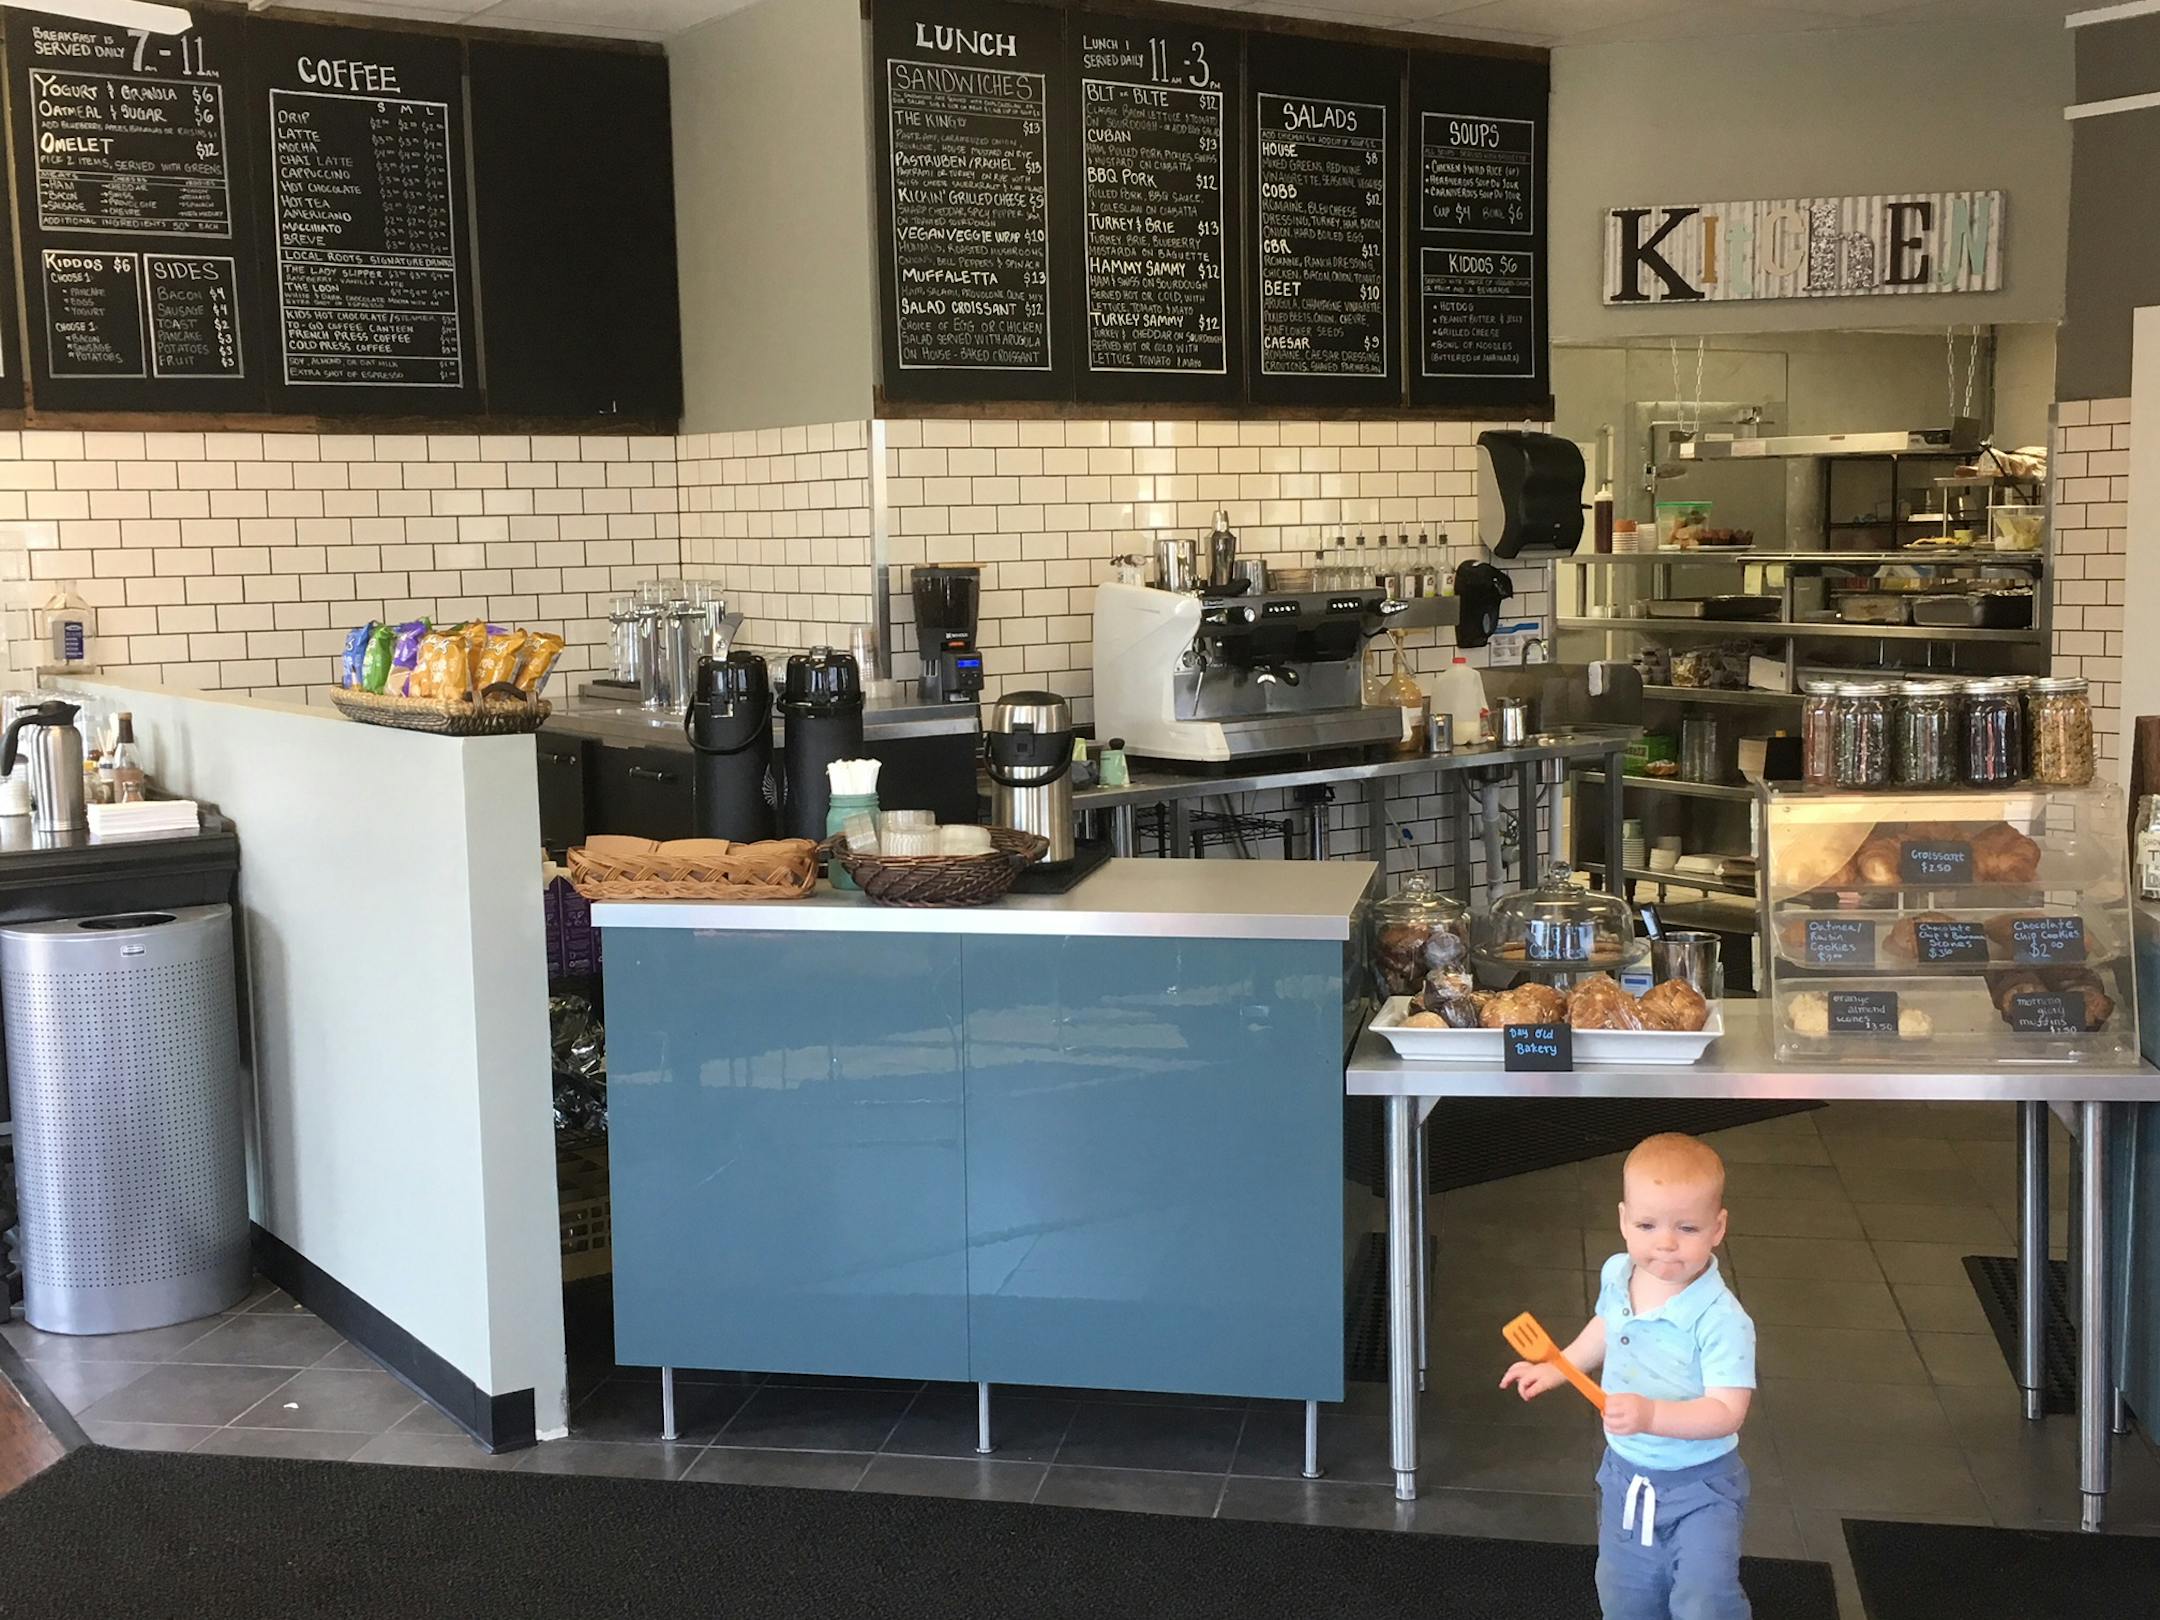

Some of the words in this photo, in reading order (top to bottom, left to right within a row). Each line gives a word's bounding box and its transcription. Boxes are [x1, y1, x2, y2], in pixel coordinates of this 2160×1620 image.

[32, 26, 97, 45] BREAKFAST
[104, 35, 114, 45] IS
[915, 21, 1017, 57] LUNCH
[1083, 35, 1118, 50] LUNCH
[34, 40, 90, 57] SERVED
[95, 45, 126, 58] DAILY
[1083, 54, 1119, 69] SERVED
[1120, 54, 1143, 68] DAILY
[297, 56, 401, 93] COFFEE
[34, 74, 99, 100] YOGURT
[121, 86, 177, 101] GRANOLA
[192, 86, 214, 105] $6
[895, 64, 1033, 101] SANDWICHES
[1087, 83, 1115, 102] BLT
[1133, 87, 1169, 107] BLTE
[1200, 94, 1218, 110] $12
[39, 100, 102, 119] OATMEAL
[121, 104, 167, 123] SUGAR
[194, 105, 214, 127] $6
[278, 110, 311, 125] DRIP
[1283, 102, 1358, 132] SALADS
[894, 110, 921, 126] THE
[1022, 120, 1041, 136] $13
[278, 128, 321, 143] LATTE
[1088, 129, 1132, 143] CUBAN
[1199, 137, 1217, 151] $13
[1450, 121, 1500, 148] SOUPS
[40, 132, 114, 154] OMELET
[195, 141, 219, 160] $12
[278, 142, 318, 154] MOCHA
[1262, 142, 1298, 158] HOUSE
[1365, 152, 1378, 165] $8
[40, 156, 63, 165] PICK
[67, 156, 74, 165] 2
[115, 159, 156, 172] SERVED
[161, 162, 181, 173] WITH
[184, 164, 222, 175] GREENS
[280, 154, 312, 166] CHAI
[317, 156, 354, 167] LATTE
[280, 167, 351, 180] CAPPUCCINO
[1025, 161, 1042, 176] $13
[1087, 167, 1118, 183] BBQ
[1122, 168, 1157, 188] PORK
[1196, 174, 1218, 190] $12
[280, 181, 304, 193] HOT
[308, 182, 363, 195] CHOCOLATE
[1262, 183, 1298, 199] COBB
[1365, 193, 1382, 206] $12
[307, 197, 331, 209] TEA
[949, 191, 992, 206] GRILLED
[283, 209, 352, 223] AMERICANO
[1433, 205, 1450, 217] CUP
[1455, 202, 1471, 224] $4
[1508, 203, 1524, 224] $6
[43, 216, 96, 225] ADDITIONAL
[102, 218, 166, 228] INGREDIENTS
[1088, 213, 1133, 231] TURKEY
[1145, 218, 1175, 234] BRIE
[1198, 221, 1219, 237] $13
[283, 233, 326, 247] BREVE
[897, 227, 945, 241] VEGAN
[946, 228, 992, 243] VEGGIE
[1024, 229, 1045, 245] $10
[1264, 239, 1292, 254] CBR
[1362, 243, 1380, 258] $12
[44, 254, 103, 272] KIDDOS
[113, 256, 131, 274] $6
[285, 251, 323, 261] LOCAL
[327, 252, 363, 264] ROOTS
[370, 256, 424, 267] SIGNATURE
[1449, 253, 1494, 274] KIDDOS
[1500, 255, 1518, 276] $6
[154, 261, 220, 281] SIDES
[284, 264, 305, 274] THE
[310, 267, 337, 276] LADY
[342, 269, 384, 279] SLIPPER
[1089, 257, 1142, 275] HAMMY
[1146, 260, 1186, 277] SAMMY
[1198, 263, 1220, 280] $12
[51, 272, 84, 284] CHOOSE
[902, 268, 999, 286] MUFFALETTA
[1024, 271, 1047, 288] $13
[158, 286, 202, 301] BACON
[209, 286, 224, 301] $4
[284, 282, 307, 292] THE
[312, 284, 340, 293] LOON
[1264, 280, 1301, 297] BEET
[1360, 284, 1380, 300] $10
[71, 306, 105, 317] YOGURT
[158, 303, 205, 316] SAUSAGE
[212, 303, 228, 317] $4
[285, 309, 312, 320] KIDS
[901, 298, 946, 315] SALAD
[952, 301, 1017, 316] CROISSANT
[1025, 301, 1044, 318] $12
[55, 322, 87, 332] CHOOSE
[157, 318, 198, 329] TOAST
[214, 318, 230, 332] $2
[369, 324, 414, 334] CANTEEN
[900, 318, 932, 331] CHOICE
[953, 317, 975, 332] EGG
[981, 320, 995, 333] OR
[1000, 321, 1043, 335] CHICKEN
[1090, 312, 1140, 326] TURKEY
[1144, 314, 1183, 328] SAMMY
[1198, 314, 1220, 331] $12
[71, 334, 100, 343] BACON
[158, 330, 202, 342] PANCAKE
[217, 332, 233, 345] $3
[288, 330, 329, 340] FRENCH
[334, 331, 369, 342] PRESS
[373, 333, 411, 344] COFFEE
[901, 331, 933, 345] SALAD
[937, 333, 972, 345] SERVED
[974, 334, 1000, 345] WITH
[1264, 336, 1311, 350] CAESAR
[1364, 336, 1380, 351] $9
[158, 343, 209, 356] POTATOES
[219, 345, 233, 357] $3
[289, 340, 317, 350] COLD
[319, 341, 351, 352] PRESS
[356, 343, 393, 353] COFFEE
[903, 348, 917, 360] ON
[74, 352, 123, 364] POTATOES
[159, 355, 195, 366] FRUIT
[1911, 849, 1965, 862] Croissant
[2013, 919, 2074, 931] Chocolate
[2040, 930, 2079, 940] Cookies
[1509, 1028, 1529, 1039] Day
[1535, 1028, 1554, 1040] Old
[1515, 1042, 1558, 1057] Bakery
